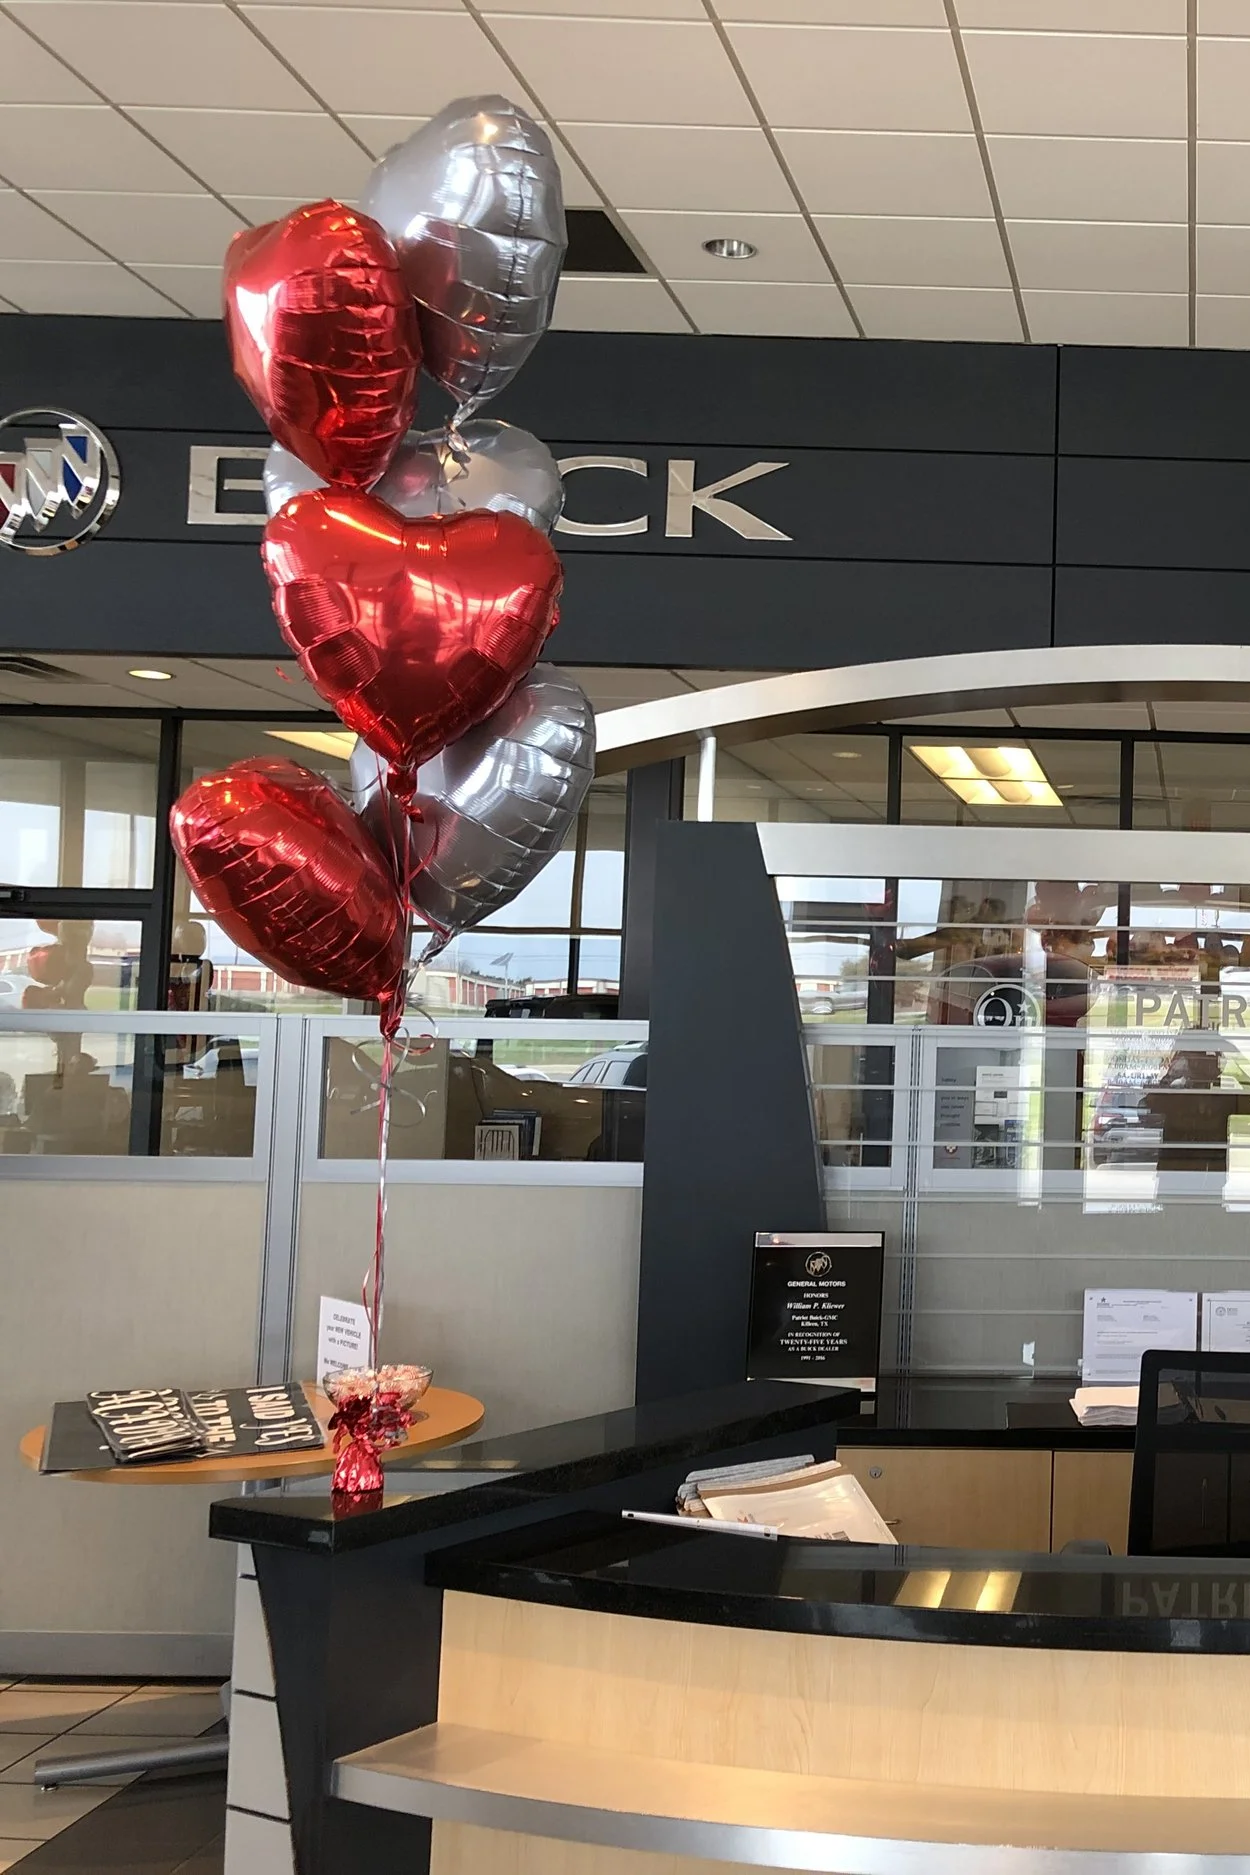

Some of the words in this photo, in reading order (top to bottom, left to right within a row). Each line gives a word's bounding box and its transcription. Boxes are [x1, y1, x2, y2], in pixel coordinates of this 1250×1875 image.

[187, 444, 794, 542] BCK
[333, 1313, 356, 1325] CELEBRATE
[192, 1399, 230, 1416] TO
[248, 1393, 295, 1420] SAID
[205, 1415, 237, 1443] THE
[239, 1418, 316, 1446] YES
